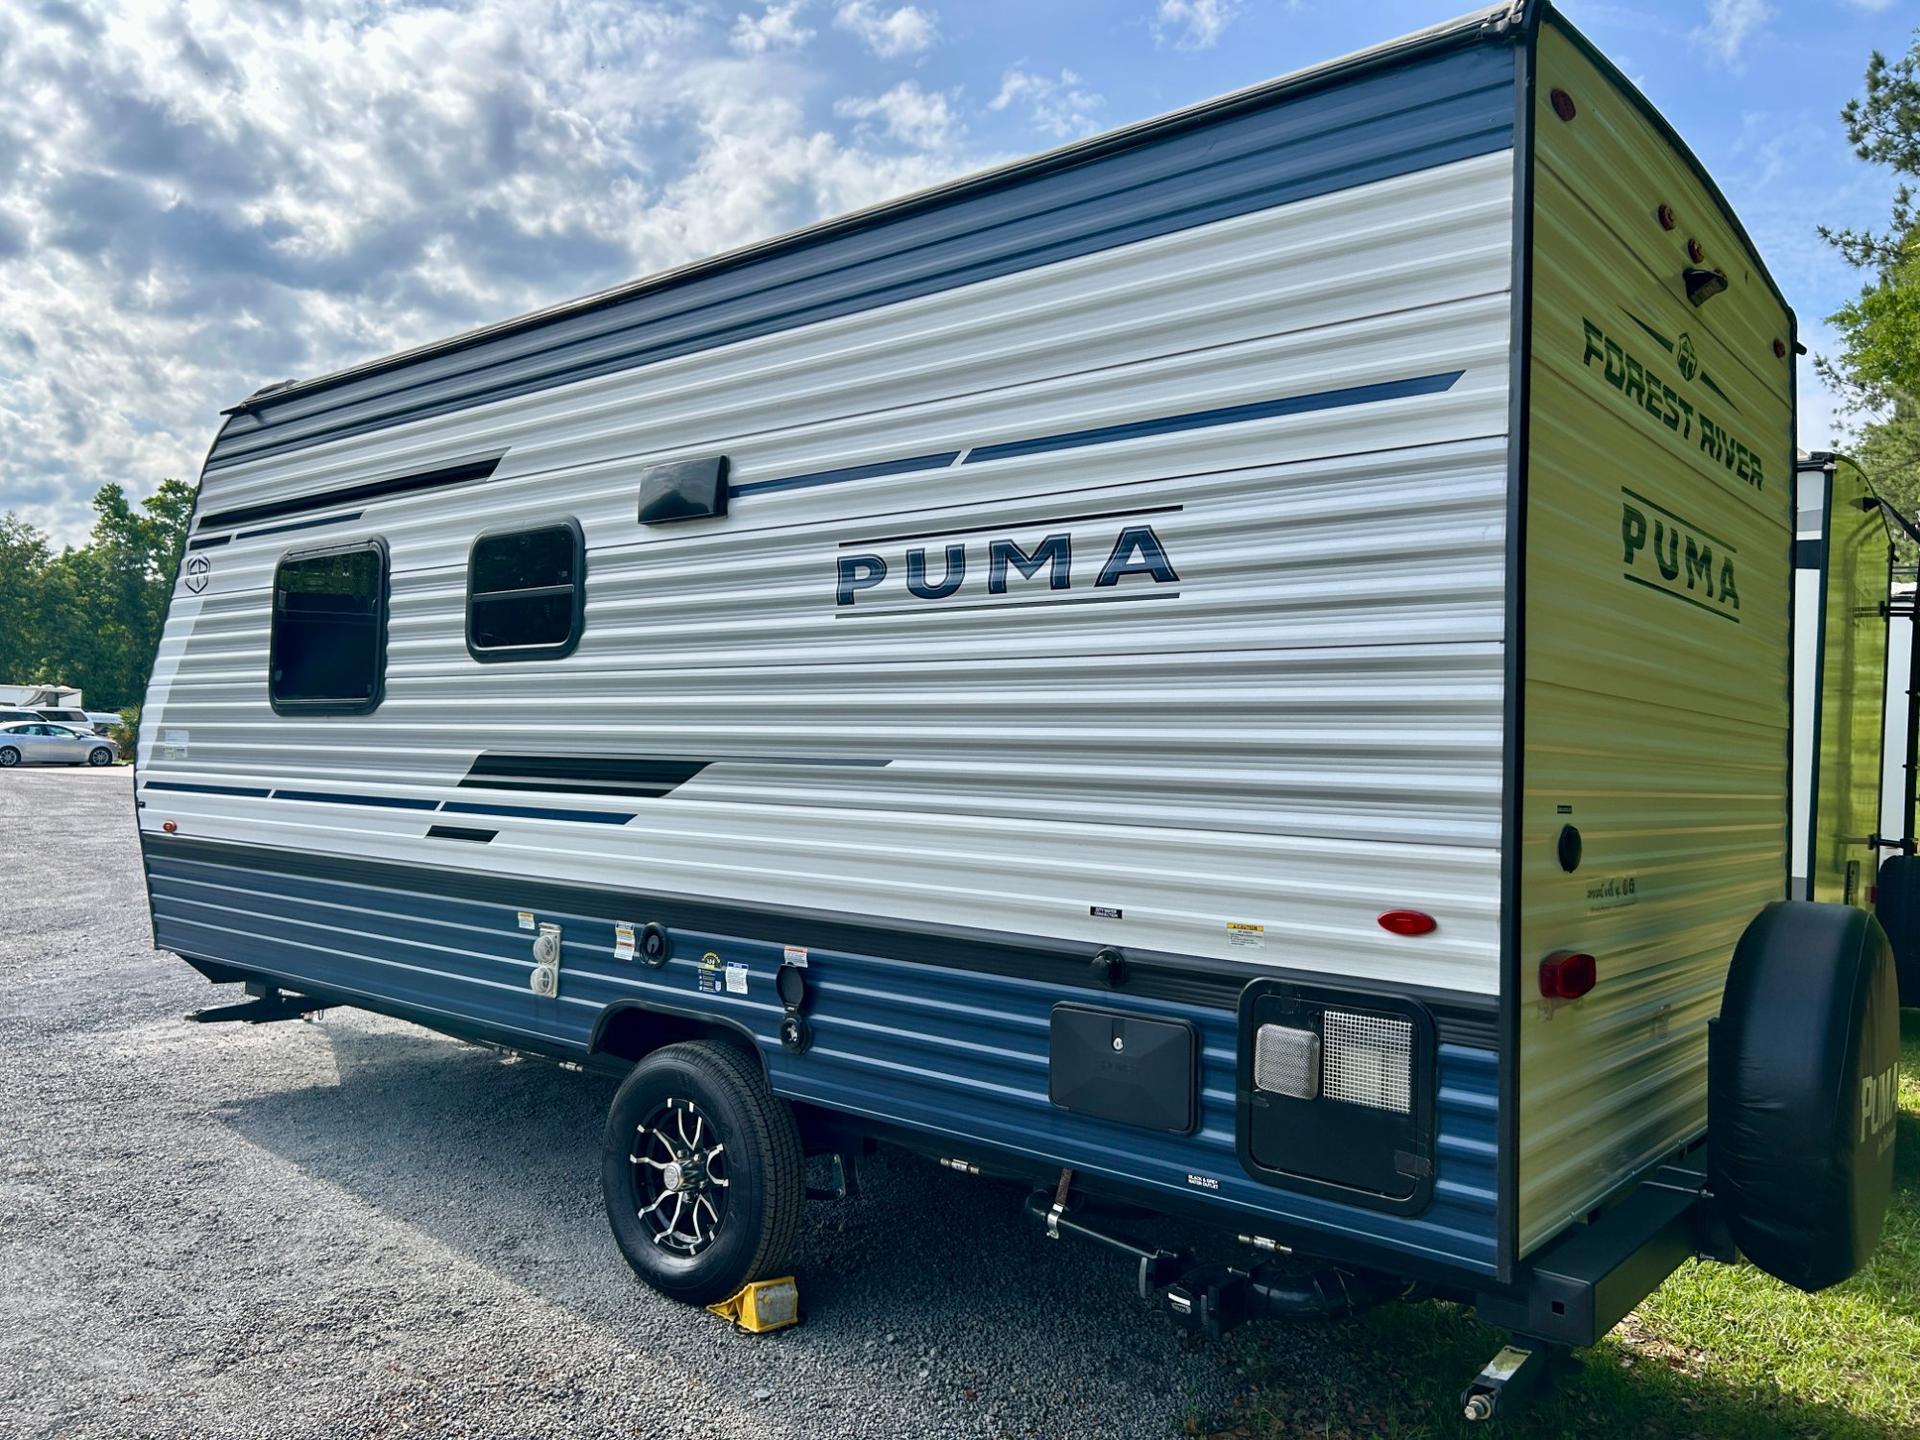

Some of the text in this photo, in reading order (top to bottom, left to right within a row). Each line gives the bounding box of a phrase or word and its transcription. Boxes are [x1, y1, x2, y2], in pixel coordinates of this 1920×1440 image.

[1582, 316, 1764, 492] FOREST RIVER
[836, 524, 1181, 606] PUMA
[1622, 502, 1740, 610] PUMA
[1861, 1061, 1899, 1142] PUMA
